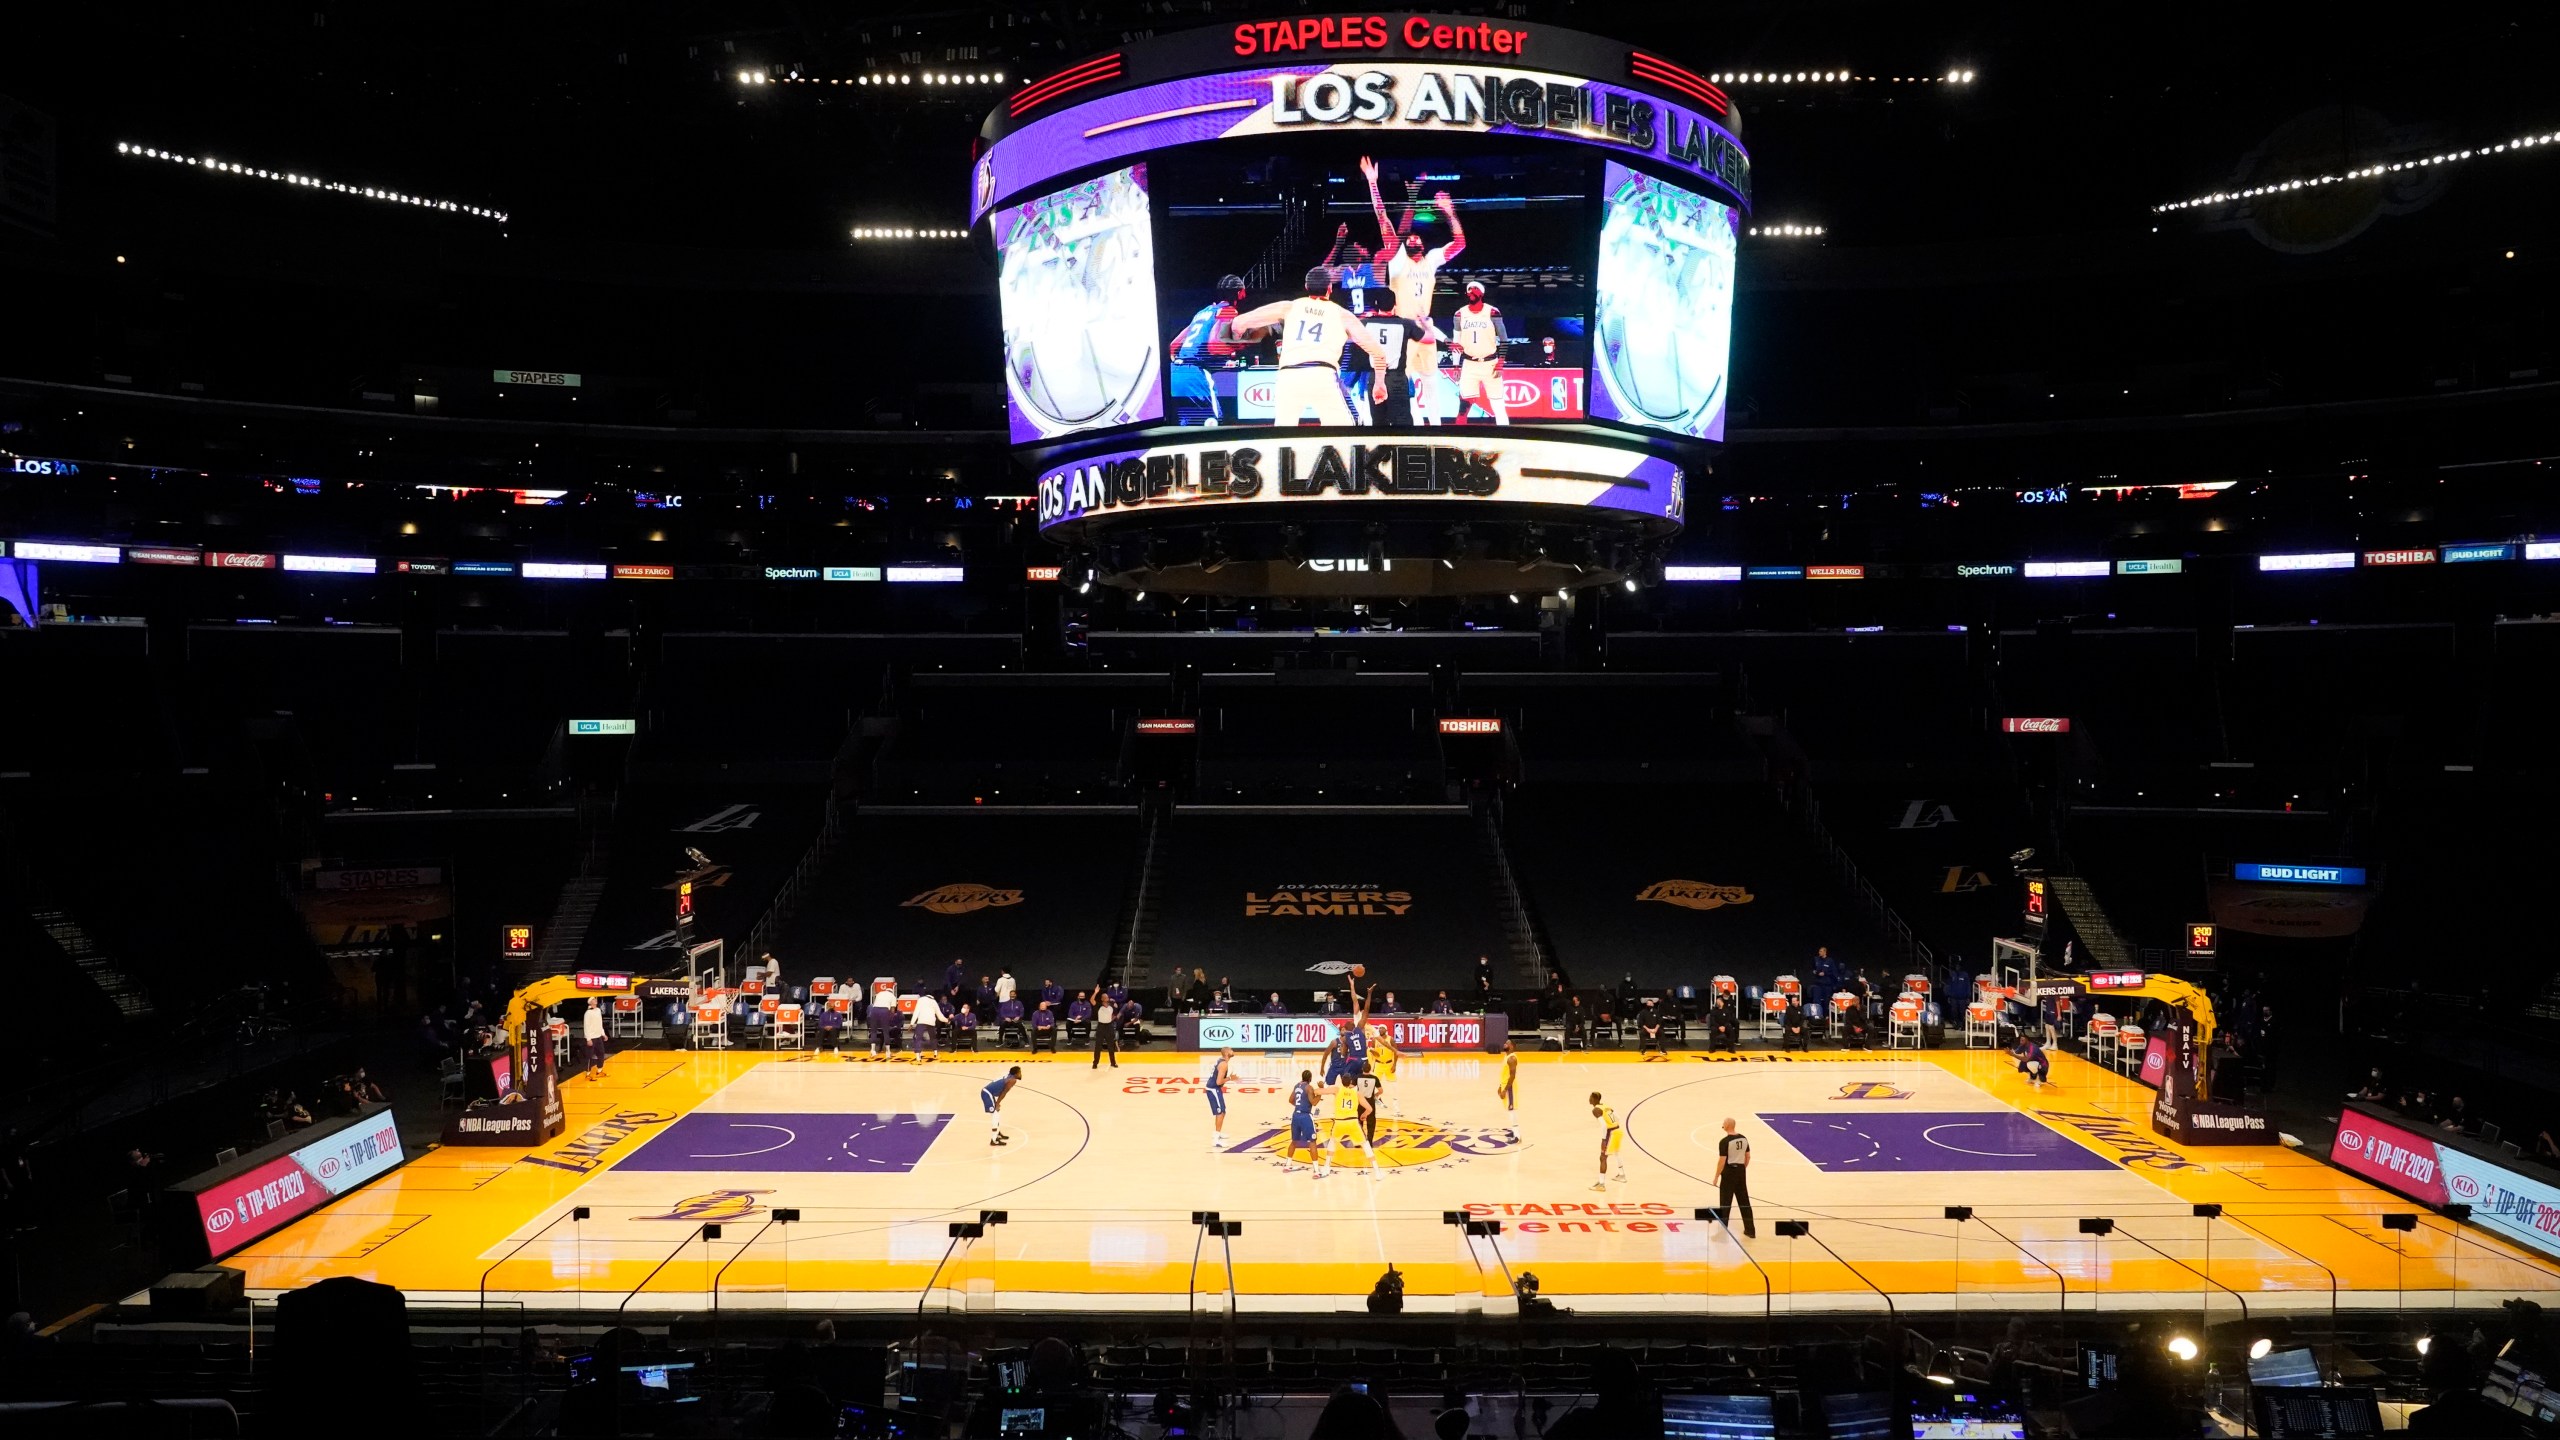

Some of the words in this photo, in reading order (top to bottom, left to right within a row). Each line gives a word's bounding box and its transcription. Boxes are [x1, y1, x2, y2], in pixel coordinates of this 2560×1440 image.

[1234, 17, 1389, 56] STAPLES
[1403, 17, 1528, 55] Center
[1271, 70, 1397, 126] LOS
[1404, 71, 1656, 150] ANGELES
[1296, 319, 1324, 343] 14
[1379, 328, 1389, 345] 5
[510, 372, 565, 385] STAPLES
[1068, 448, 1263, 513] ANGELES
[1279, 440, 1501, 498] LAKERS
[151, 553, 176, 561] MANUEL
[176, 554, 200, 562] CASINO
[223, 553, 267, 568] Coca-Cola
[2364, 551, 2435, 565] TOSHIBA
[2451, 551, 2473, 559] BUD
[2473, 549, 2504, 558] LIGHT
[410, 563, 436, 571] TOYOTA
[617, 568, 643, 576] WELLS
[644, 568, 670, 576] FARGO
[765, 567, 818, 580] Spectrum
[1810, 568, 1835, 576] WELLS
[1835, 568, 1861, 576] FARGO
[1957, 564, 2013, 578] Spectrum
[833, 570, 850, 578] UCLA
[851, 570, 875, 578] Health
[601, 722, 628, 730] Health
[1440, 721, 1500, 732] TOSHIBA
[2020, 718, 2060, 732] Coca-Cola
[2261, 867, 2292, 879] BUD
[2293, 868, 2340, 881] LIGHT
[1246, 892, 1413, 903] LAKERS
[2029, 893, 2042, 913] 24
[680, 895, 691, 914] 24
[1245, 904, 1413, 916] FAMILY
[510, 938, 526, 949] 24
[2193, 936, 2209, 947] 24
[650, 986, 690, 996] LAKERS.CO
[1915, 981, 1922, 989] G
[768, 1000, 775, 1008] G
[905, 1000, 911, 1008] G
[1772, 999, 1779, 1007] G
[705, 1010, 712, 1018] G
[783, 1010, 791, 1019] G
[1903, 1009, 1910, 1018] G
[1979, 1009, 1987, 1017] G
[1206, 1028, 1232, 1039] KIA
[1295, 1023, 1327, 1043] 2020
[1448, 1023, 1480, 1044] 2020
[2182, 1025, 2190, 1050] NBA
[529, 1029, 538, 1054] NBA
[1353, 1038, 1362, 1051] 9
[530, 1056, 538, 1073] TV
[1690, 1055, 1793, 1063] wish
[2149, 1055, 2161, 1067] KIA
[2182, 1052, 2190, 1069] TV
[1363, 1080, 1368, 1088] 5
[1295, 1093, 1302, 1106] 2
[1342, 1098, 1353, 1110] 14
[2159, 1100, 2178, 1118] Happy
[466, 1118, 482, 1132] NBA
[482, 1117, 511, 1133] League
[511, 1117, 532, 1131] Pass
[2155, 1111, 2180, 1130] Holidays
[2199, 1115, 2215, 1129] NBA
[2215, 1115, 2244, 1132] League
[2244, 1116, 2265, 1130] Pass
[514, 1107, 678, 1177] LAKERS
[1735, 1140, 1743, 1151] 37
[321, 1162, 338, 1175] KIA
[376, 1126, 398, 1155] 2020
[2342, 1131, 2361, 1148] KIA
[2405, 1152, 2434, 1184] 2020
[2454, 1178, 2477, 1195] KIA
[211, 1211, 230, 1229] KIA
[278, 1169, 305, 1203] 2020
[1462, 1203, 1675, 1216] STAPLES
[1499, 1219, 1685, 1233] enter
